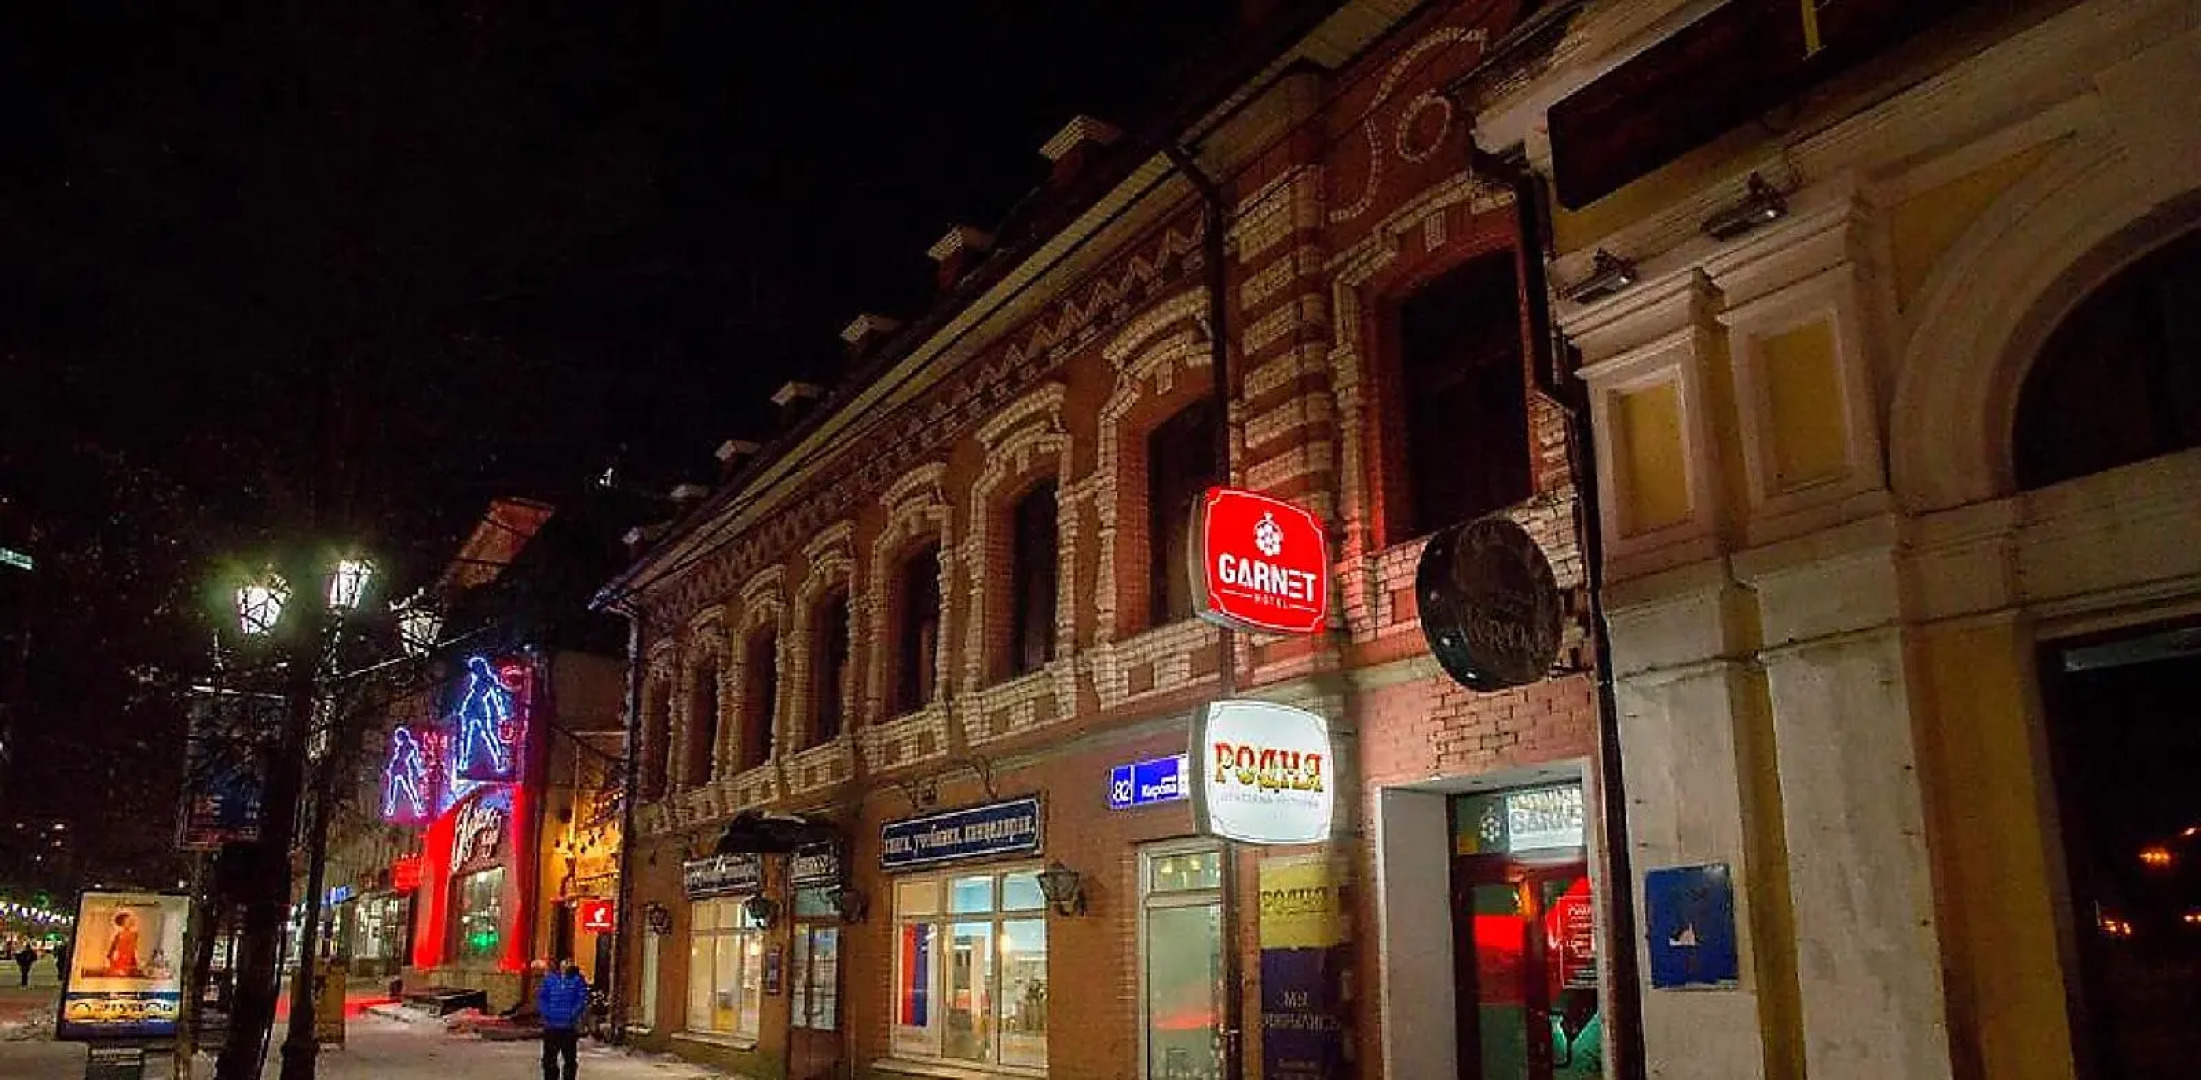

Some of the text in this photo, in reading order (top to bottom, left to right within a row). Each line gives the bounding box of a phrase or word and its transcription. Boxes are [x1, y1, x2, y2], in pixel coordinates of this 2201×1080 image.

[1218, 552, 1318, 602] GARNET
[1113, 779, 1131, 802] 82
[1214, 742, 1324, 793] РОДНЯ
